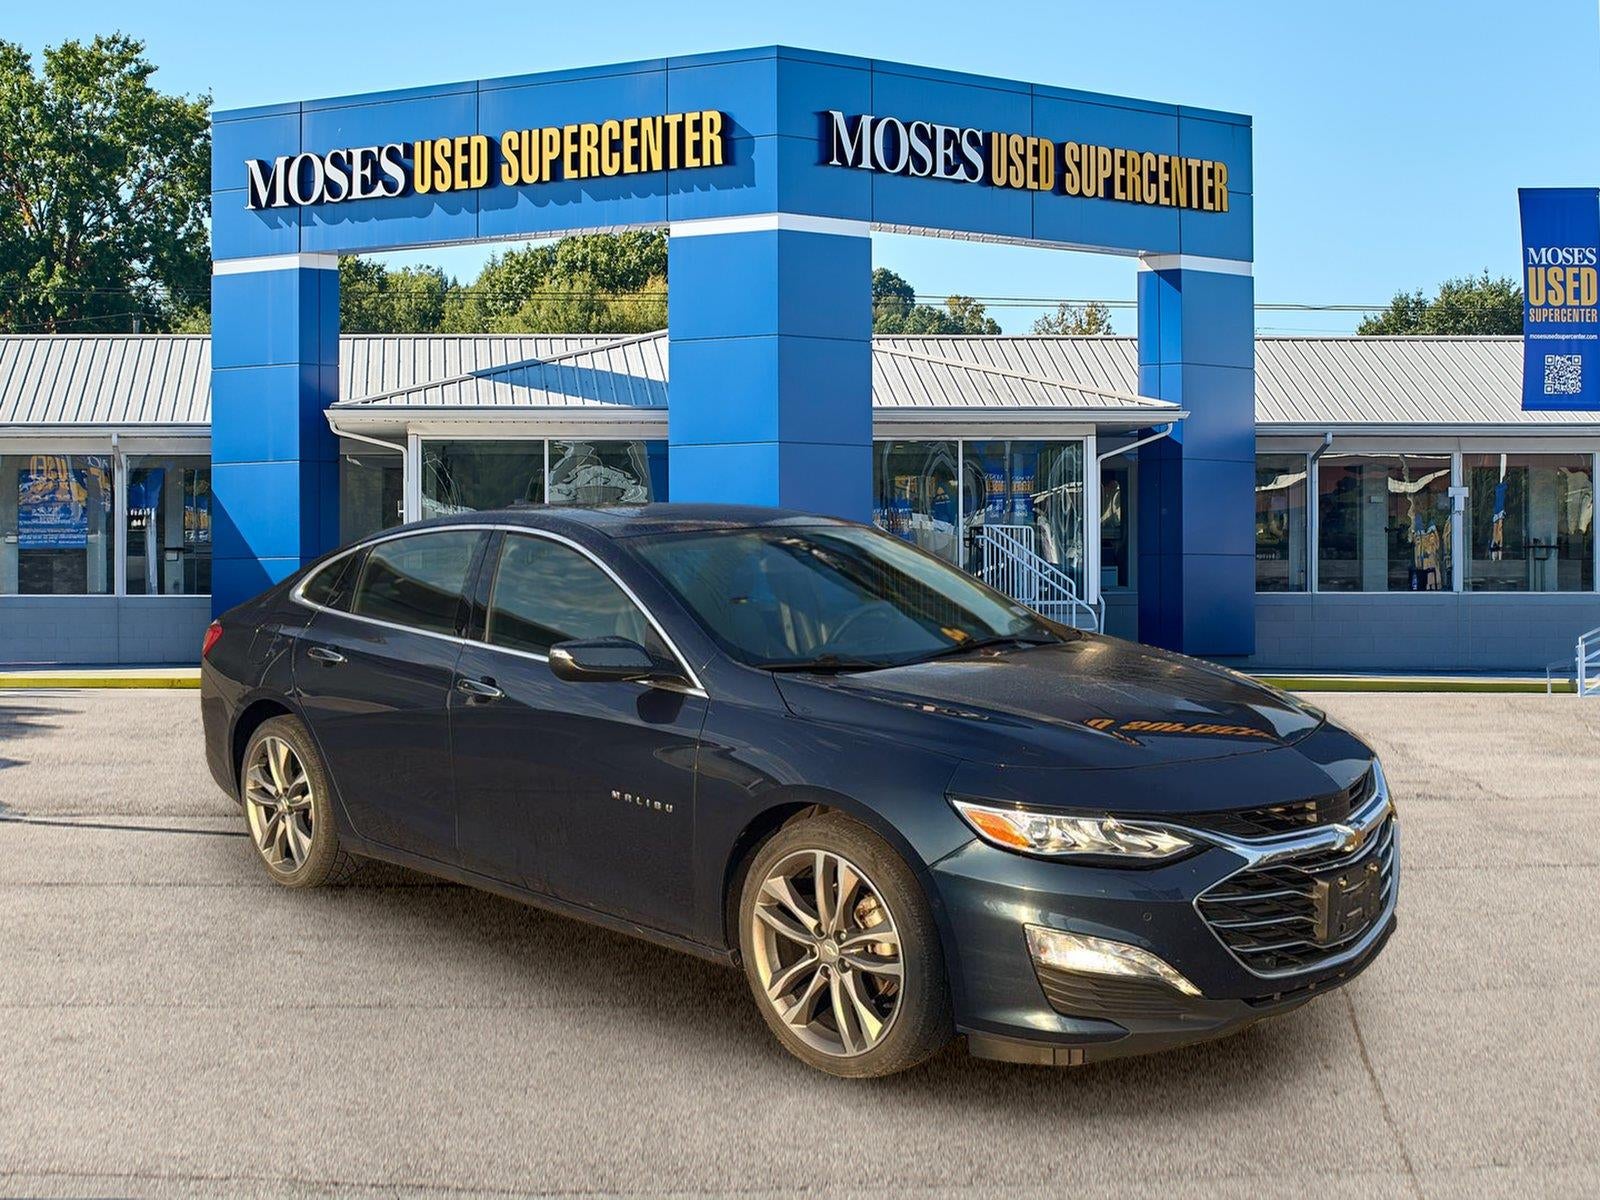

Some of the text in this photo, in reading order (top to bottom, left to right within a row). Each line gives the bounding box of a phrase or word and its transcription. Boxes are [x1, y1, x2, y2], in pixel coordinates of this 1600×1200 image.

[244, 109, 725, 210] MOSES USED SUPERCENTER
[828, 110, 1230, 212] MOSES USED SUPERCENTER
[1527, 246, 1597, 266] MOSES
[1528, 267, 1598, 307] USED
[1529, 308, 1598, 323] SUPERCENTER
[1529, 333, 1598, 341] mosesusedsupercenter.com
[611, 789, 674, 813] MALIBU
